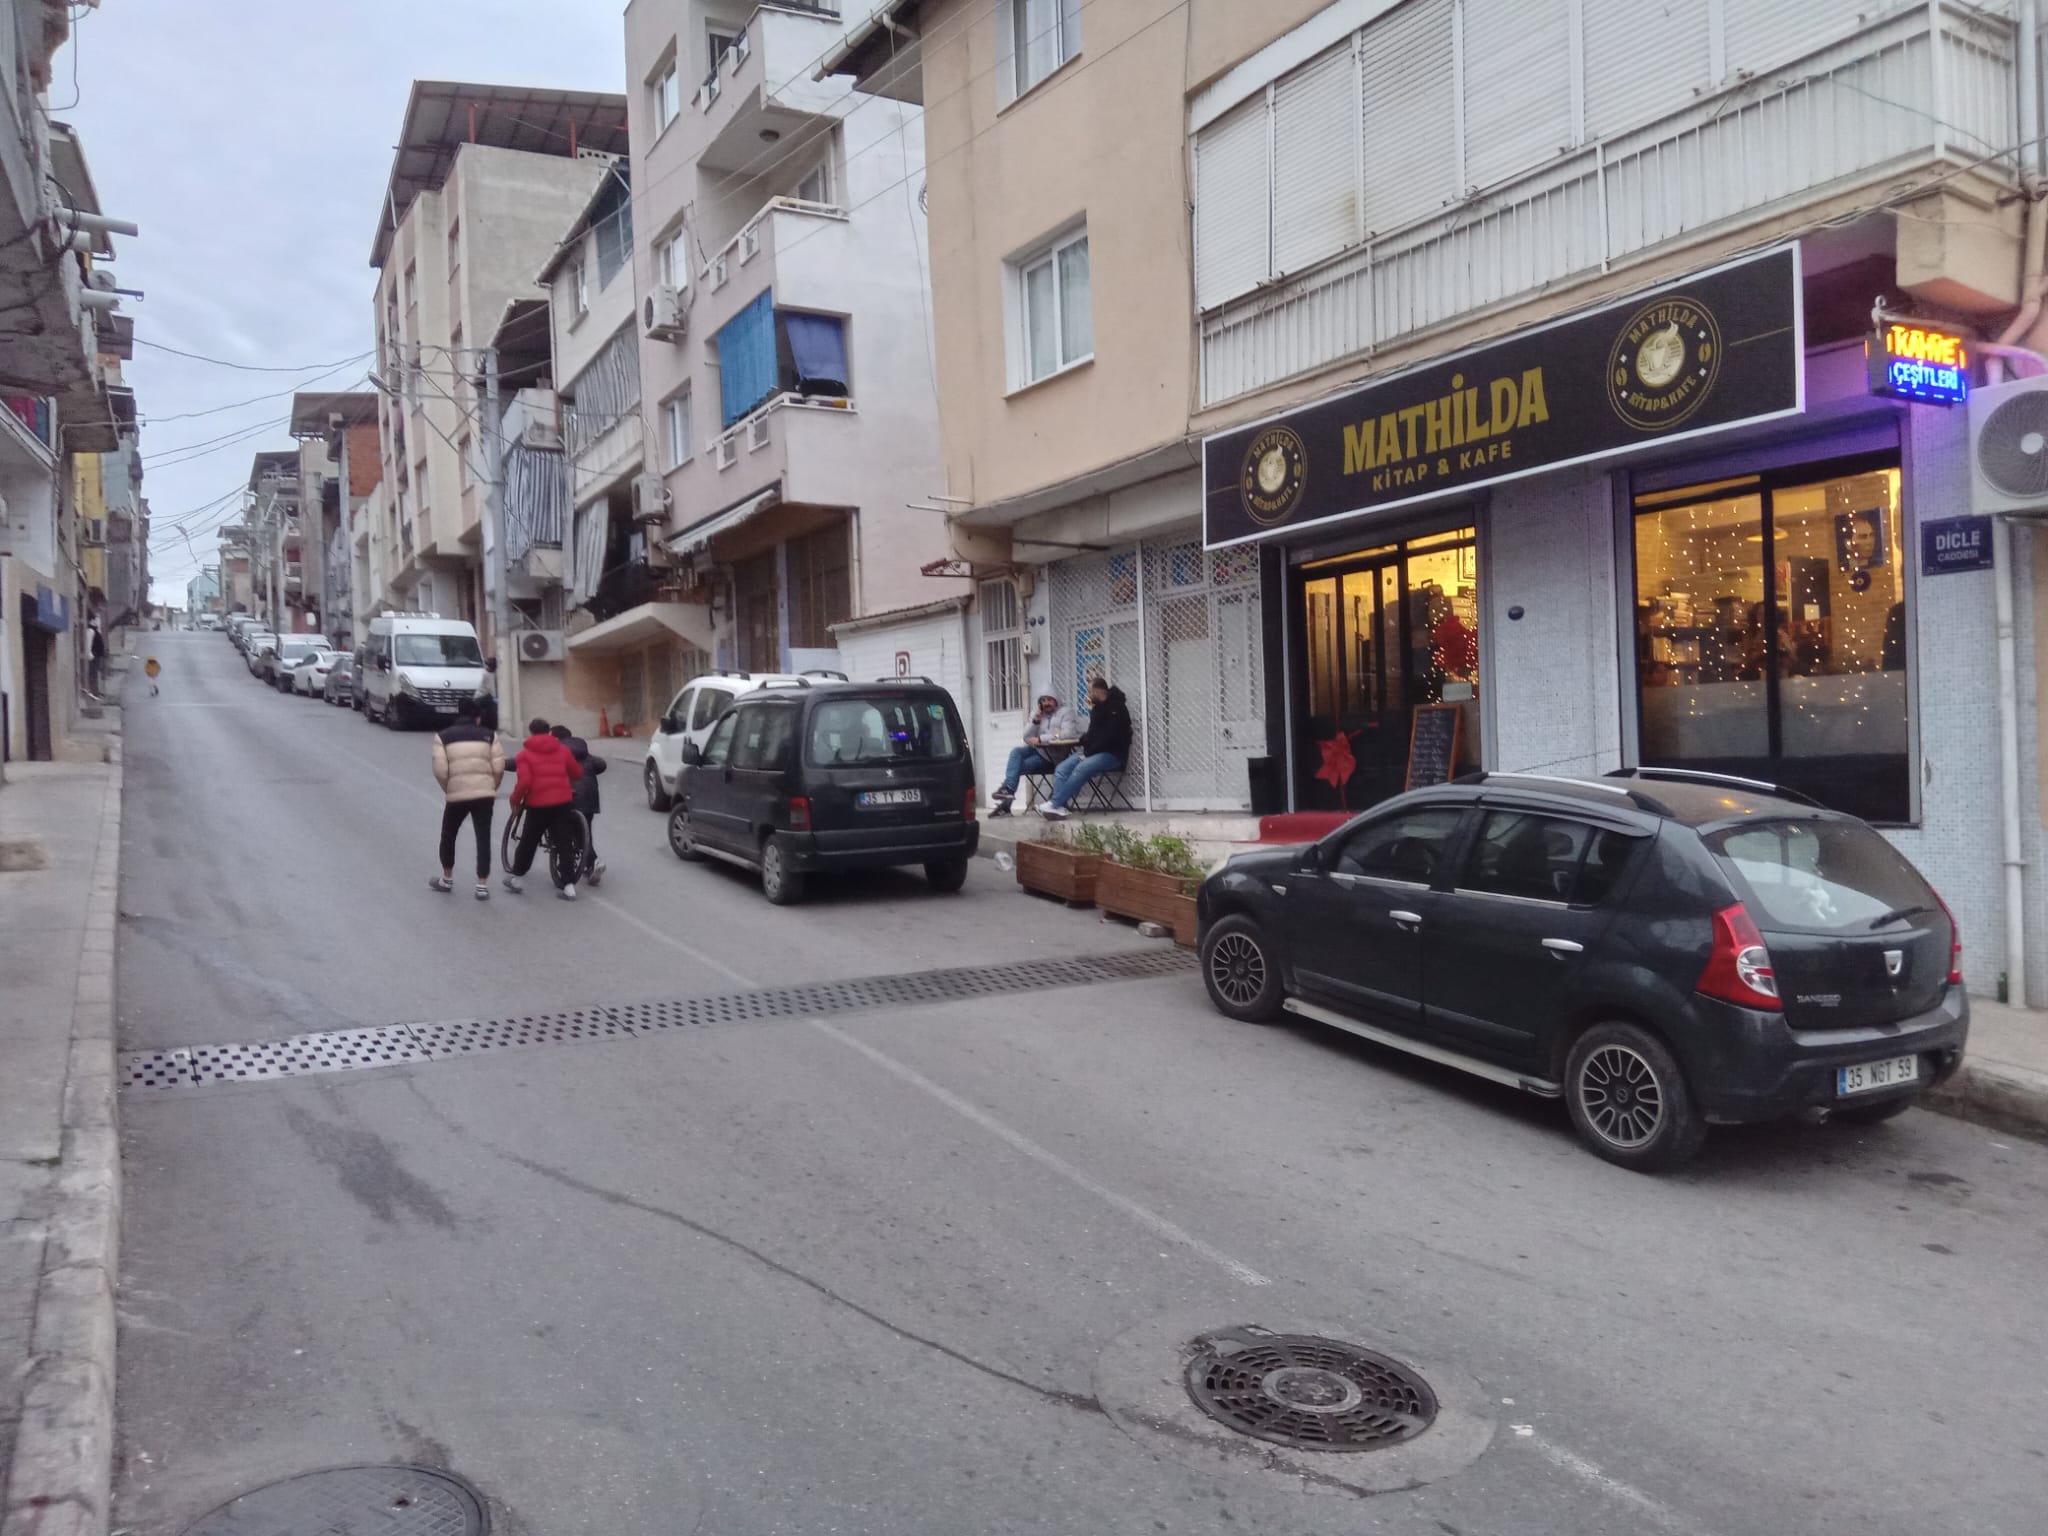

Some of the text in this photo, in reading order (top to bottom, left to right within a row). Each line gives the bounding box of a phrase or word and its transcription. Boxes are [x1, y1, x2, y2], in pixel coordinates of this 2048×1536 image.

[1894, 360, 1958, 390] ÇEŞİTLERİ
[1343, 366, 1549, 475] MATHİLDA
[1373, 440, 1512, 491] KİTAP & KAFE
[1849, 1057, 1912, 1089] 35 NGT 59
